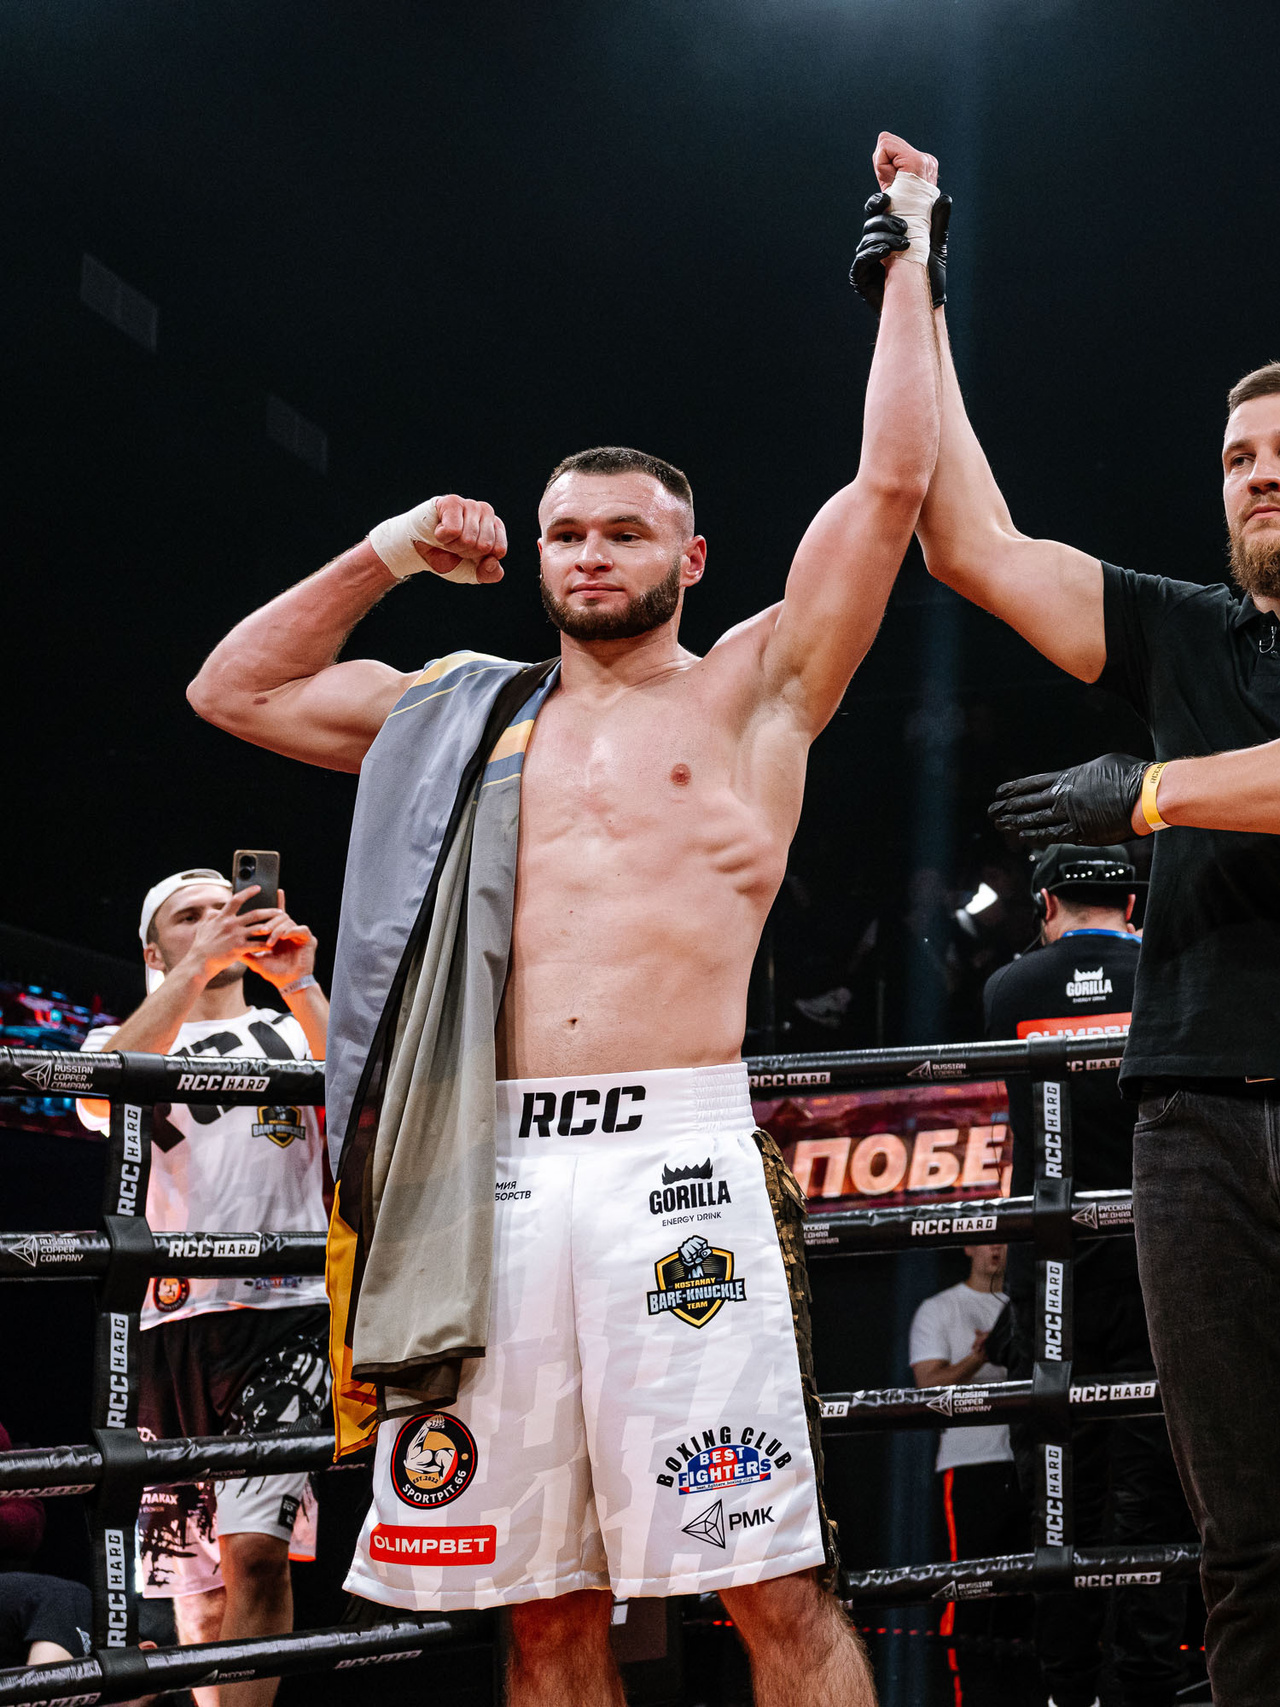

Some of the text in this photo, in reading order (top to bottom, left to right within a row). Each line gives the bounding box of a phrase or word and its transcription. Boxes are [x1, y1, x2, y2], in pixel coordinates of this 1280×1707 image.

[1066, 979, 1113, 997] GORILLA
[54, 1064, 94, 1074] RUSSIAN
[1087, 1058, 1121, 1070] HAR
[51, 1081, 93, 1091] COMPANY
[53, 1073, 87, 1082] COPPER
[177, 1074, 221, 1092] RCC
[518, 1085, 646, 1138] RCC
[792, 1124, 1013, 1199] ПОБЕ
[1045, 1133, 1062, 1178] RCC
[117, 1163, 140, 1216] RCC
[649, 1180, 732, 1215] GORILLA
[662, 1211, 722, 1227] ENERGY DRINK
[911, 1219, 951, 1236] RCC
[39, 1238, 80, 1247] RUSSIAN
[41, 1245, 75, 1253] COPPER
[168, 1241, 214, 1258] RCC
[40, 1253, 84, 1263] COMPANY
[674, 1277, 716, 1289] KOSTANAY
[649, 1281, 744, 1313] BARE-KNUCKLE
[687, 1301, 708, 1310] TEAM
[1045, 1314, 1063, 1361] RCC
[107, 1376, 128, 1429] RCC
[953, 1390, 989, 1398] RUSSIAN
[954, 1398, 983, 1406] COPPER
[1069, 1386, 1109, 1403] RCC
[656, 1426, 792, 1488] BOXING CLUB
[700, 1447, 745, 1466] BEST
[412, 1475, 439, 1485] EST.2022
[678, 1458, 772, 1487] FIGHTERS
[402, 1469, 467, 1504] SPORTPIT.66
[1047, 1500, 1064, 1547] RCC
[373, 1535, 490, 1554] OLIMPBET
[1074, 1574, 1115, 1588] RCC
[107, 1593, 127, 1648] RCC
